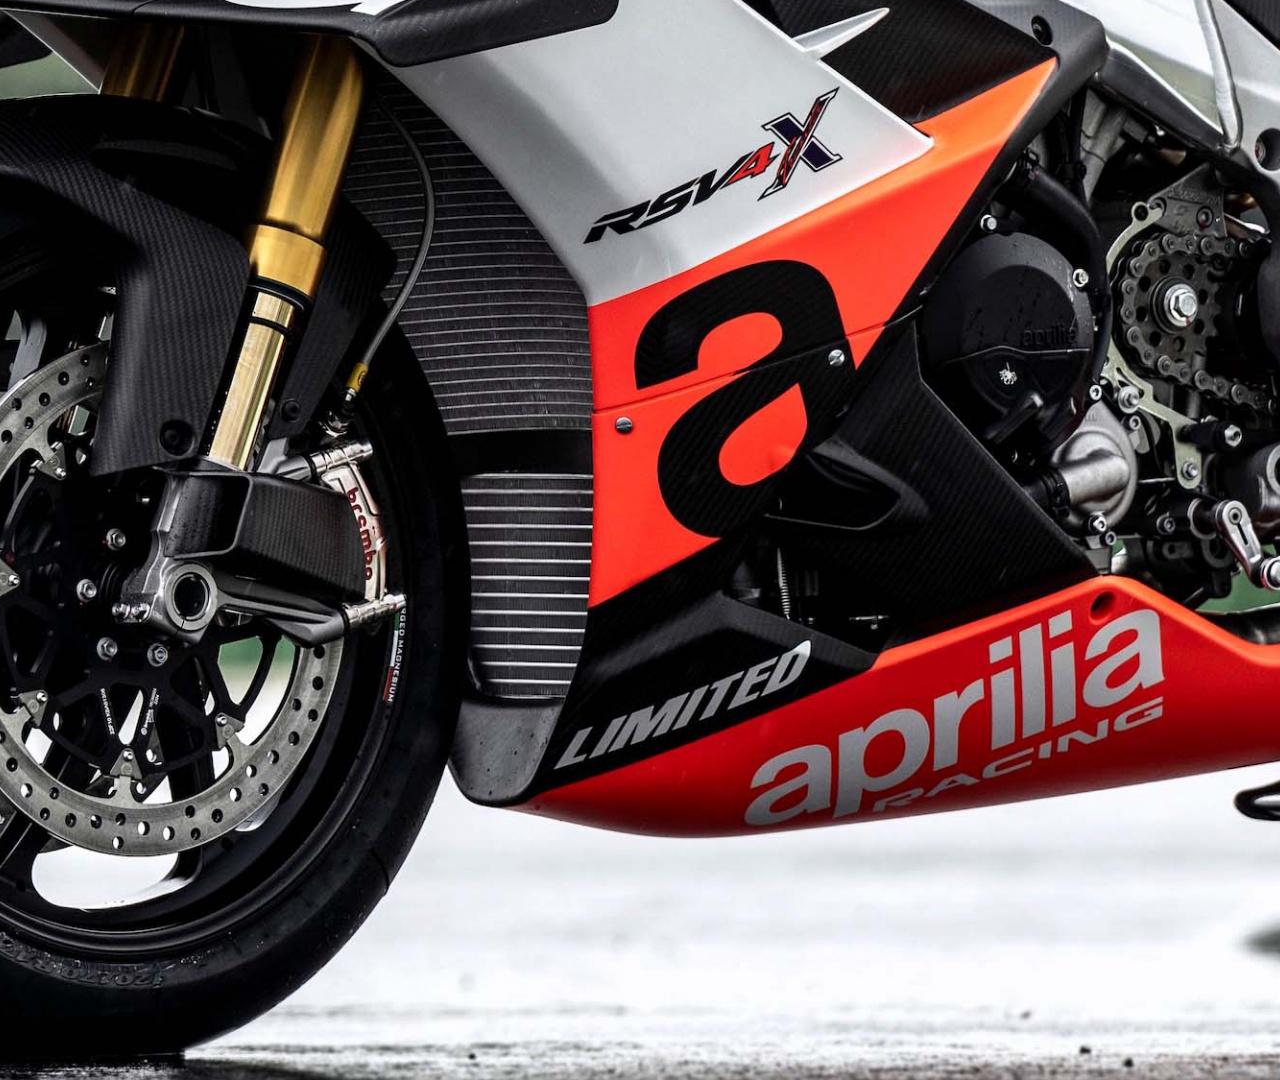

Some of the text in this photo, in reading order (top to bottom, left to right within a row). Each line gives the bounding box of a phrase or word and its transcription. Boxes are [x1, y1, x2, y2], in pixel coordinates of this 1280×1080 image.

[634, 259, 858, 539] a
[346, 487, 377, 581] brembo
[387, 606, 407, 702] RGED MAGNESIUM
[553, 639, 812, 770] LIMITED
[744, 609, 1165, 826] aprilia
[873, 696, 1164, 812] RACING
